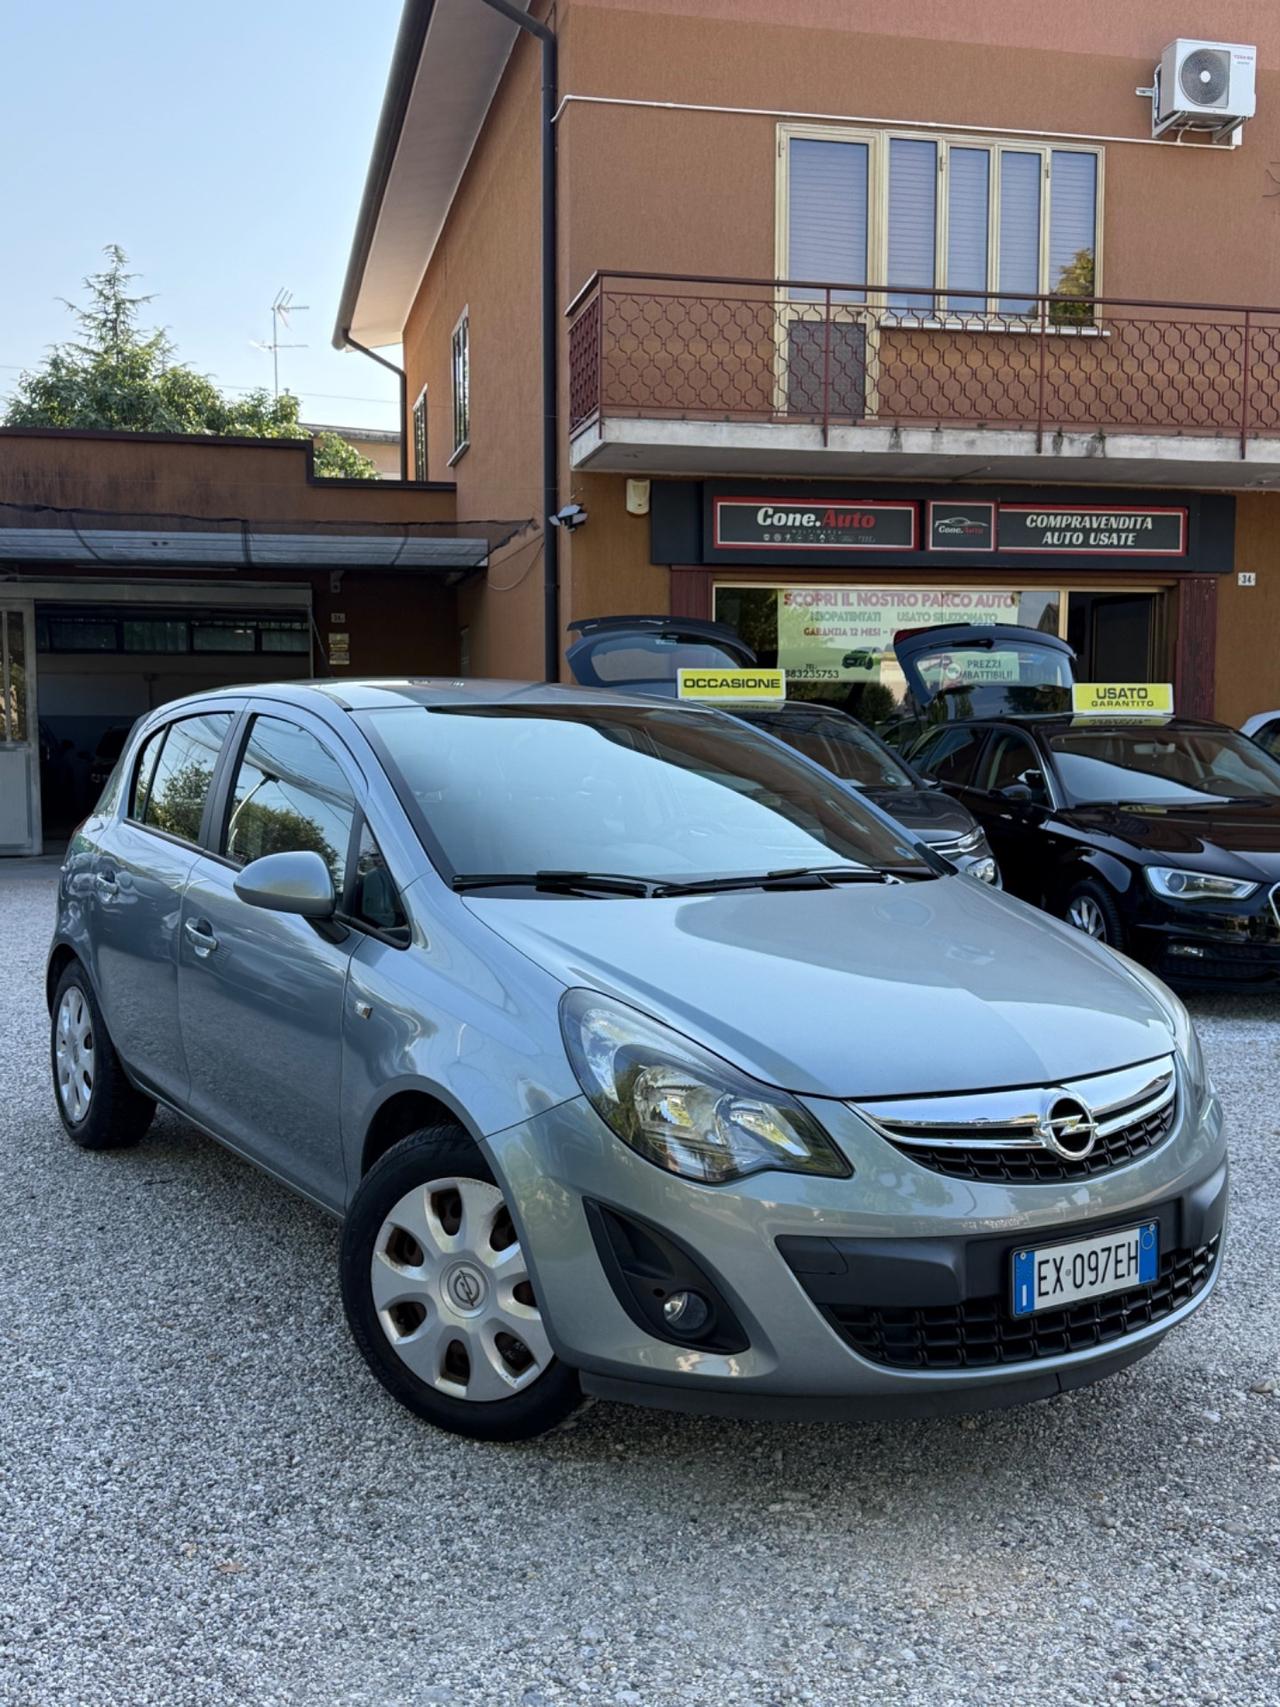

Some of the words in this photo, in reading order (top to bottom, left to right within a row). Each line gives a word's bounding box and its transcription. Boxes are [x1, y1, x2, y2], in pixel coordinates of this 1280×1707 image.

[757, 507, 876, 528] Cone.Auto
[1026, 514, 1153, 530] COMPRAVENDITA
[1042, 532, 1083, 545] AUTO
[1089, 532, 1136, 546] USATE
[784, 592, 838, 607] SCOPRI
[842, 593, 855, 607] IL
[857, 593, 918, 608] NOSTRO
[922, 593, 972, 608] PARCO
[974, 595, 1015, 608] AUTO
[897, 611, 931, 622] USATO
[967, 659, 1002, 669] PREZZI
[683, 678, 781, 689] OCCASIONE
[1096, 687, 1148, 700] USATO
[1038, 1256, 1064, 1297] EX
[1073, 1240, 1139, 1289] 097EH
